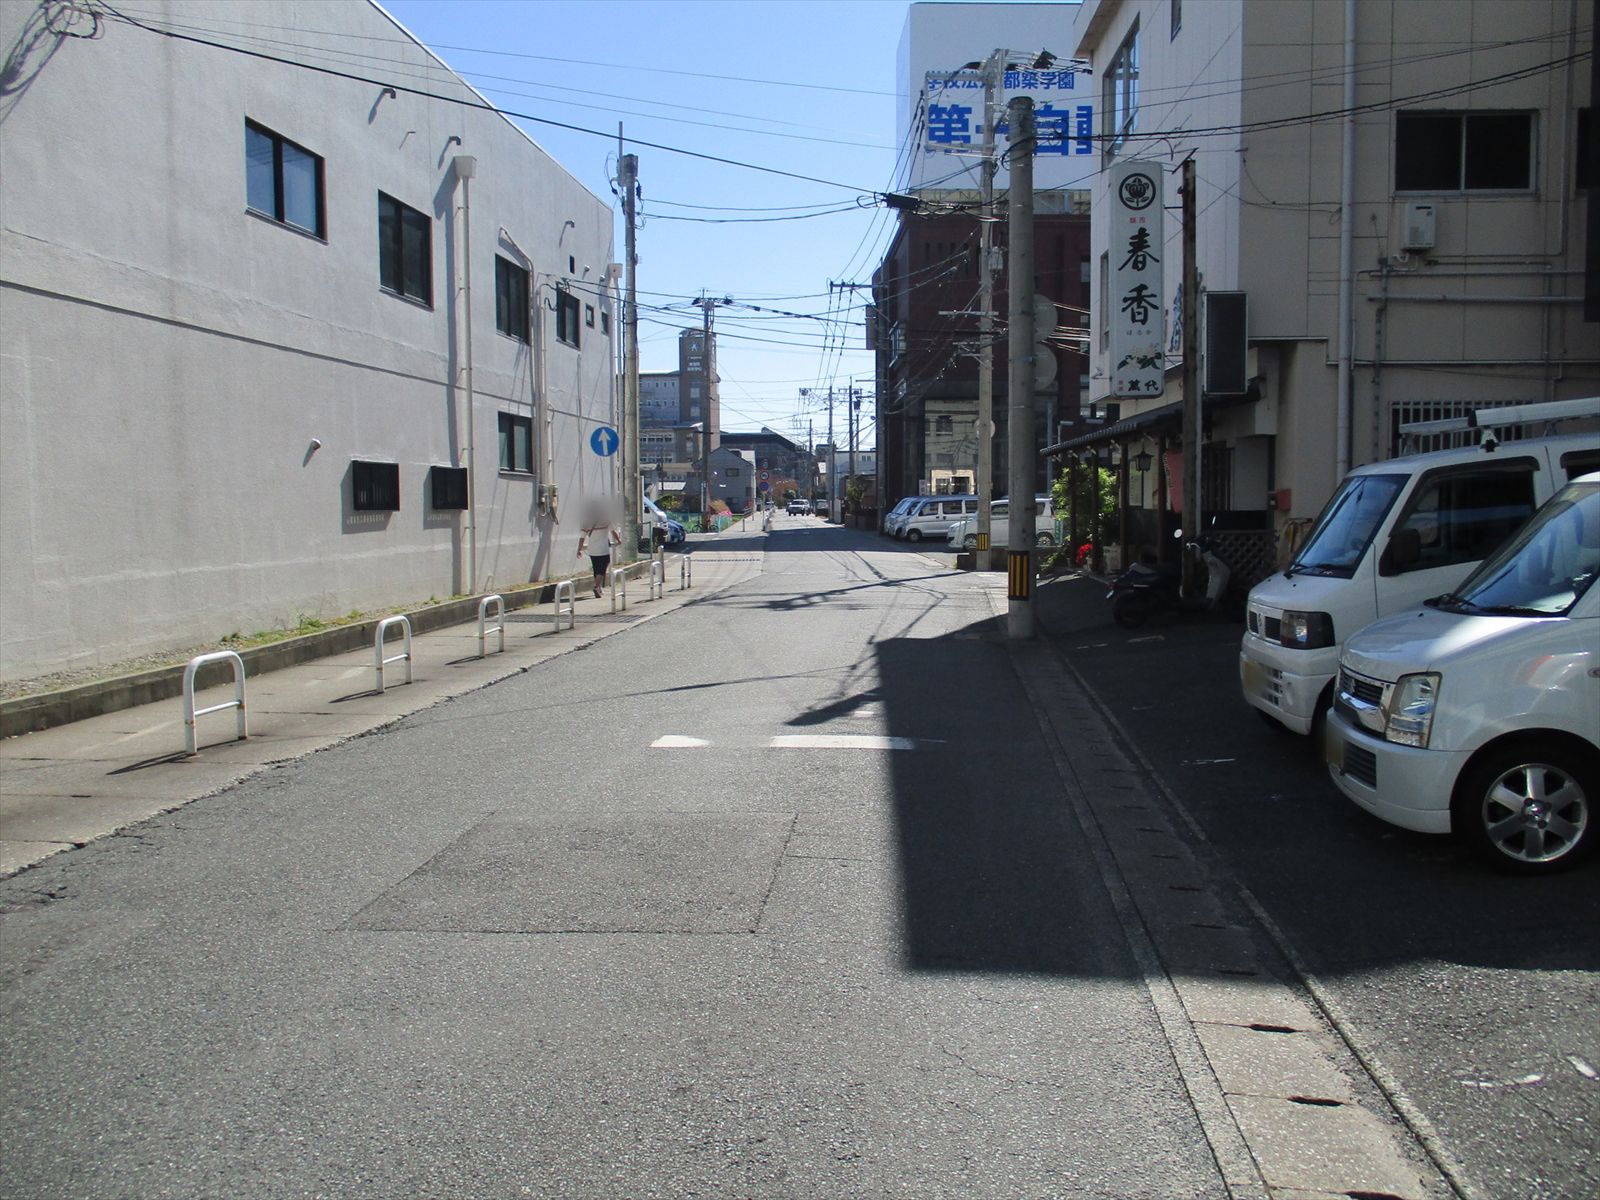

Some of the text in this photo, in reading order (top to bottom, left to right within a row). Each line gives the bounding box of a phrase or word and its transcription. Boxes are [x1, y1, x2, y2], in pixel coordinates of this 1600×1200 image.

[1003, 71, 1075, 90] 都築学園
[1118, 226, 1160, 326] 春香
